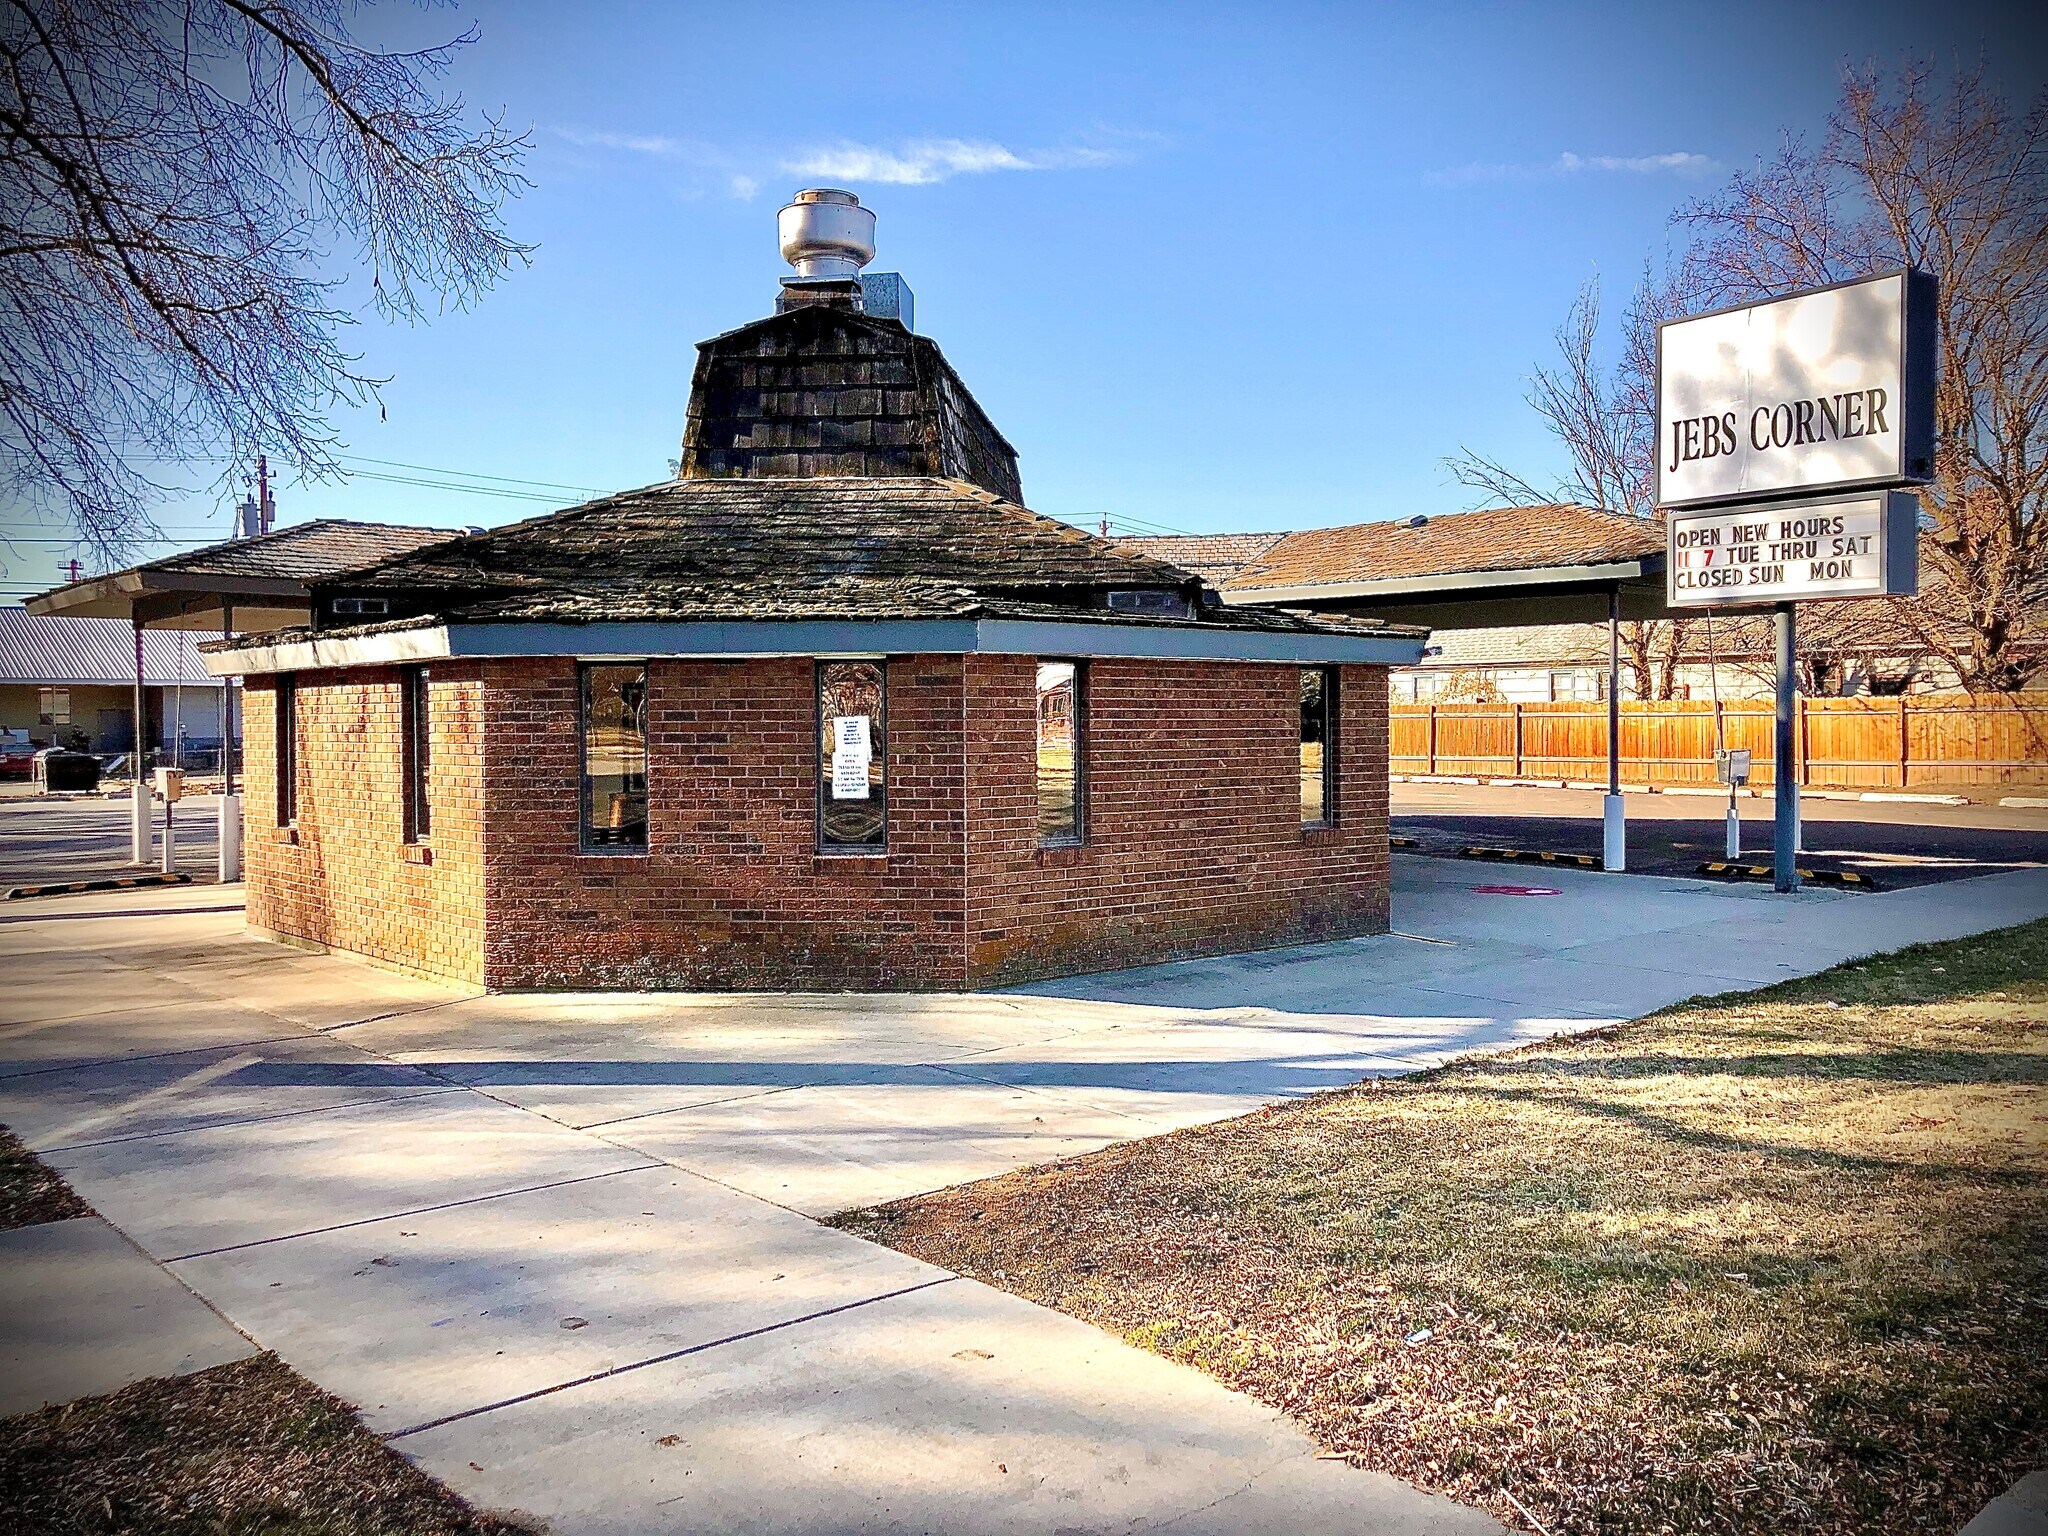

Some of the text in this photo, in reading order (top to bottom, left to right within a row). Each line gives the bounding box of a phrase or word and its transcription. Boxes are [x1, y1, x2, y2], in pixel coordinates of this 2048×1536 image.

[1669, 388, 1890, 473] JEBS CORNER
[1677, 516, 1844, 548] OPEN NEW HOURS
[1703, 549, 1714, 566] 7
[1726, 545, 1760, 564] TUE
[1769, 540, 1817, 561] THRU
[1832, 535, 1872, 556] SAT
[1676, 560, 1853, 589] CLOSED SUN MON
